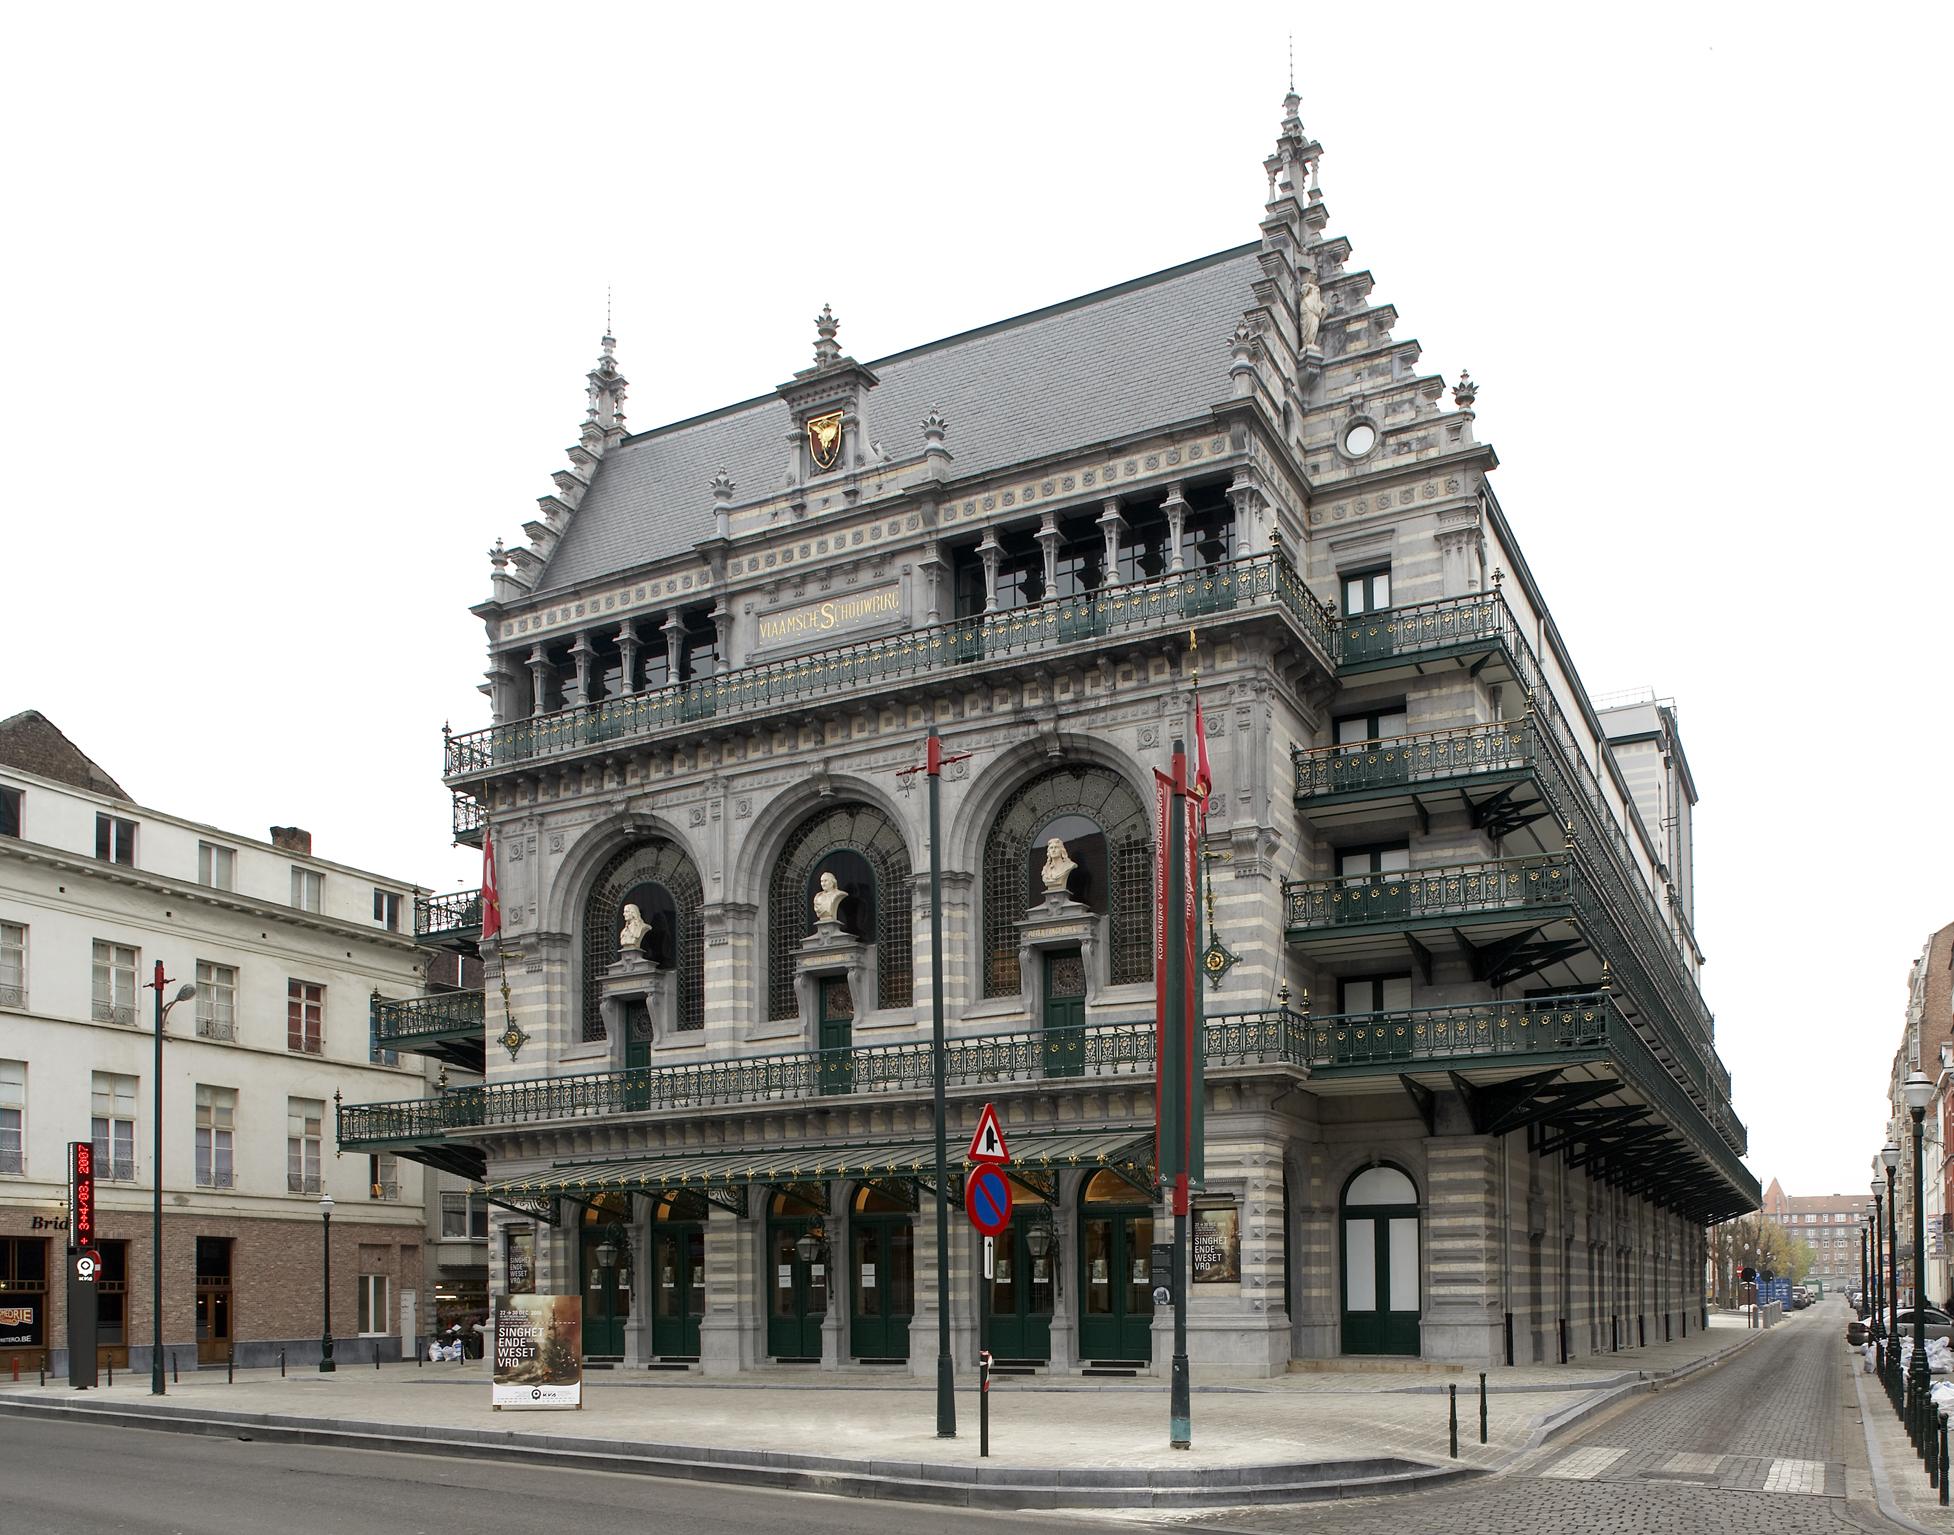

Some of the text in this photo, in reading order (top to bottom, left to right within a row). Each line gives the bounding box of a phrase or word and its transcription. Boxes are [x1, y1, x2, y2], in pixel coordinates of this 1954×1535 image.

[820, 591, 899, 629] SCHOUWBURG
[78, 1144, 89, 1174] 2007
[1194, 1236, 1228, 1245] SINGHET
[1194, 1245, 1215, 1253] ENDE
[1194, 1262, 1211, 1270] VRO
[499, 1327, 545, 1337] SINGHET
[498, 1337, 526, 1347] ENDE
[498, 1347, 536, 1357] WESET
[498, 1358, 519, 1368] VRO
